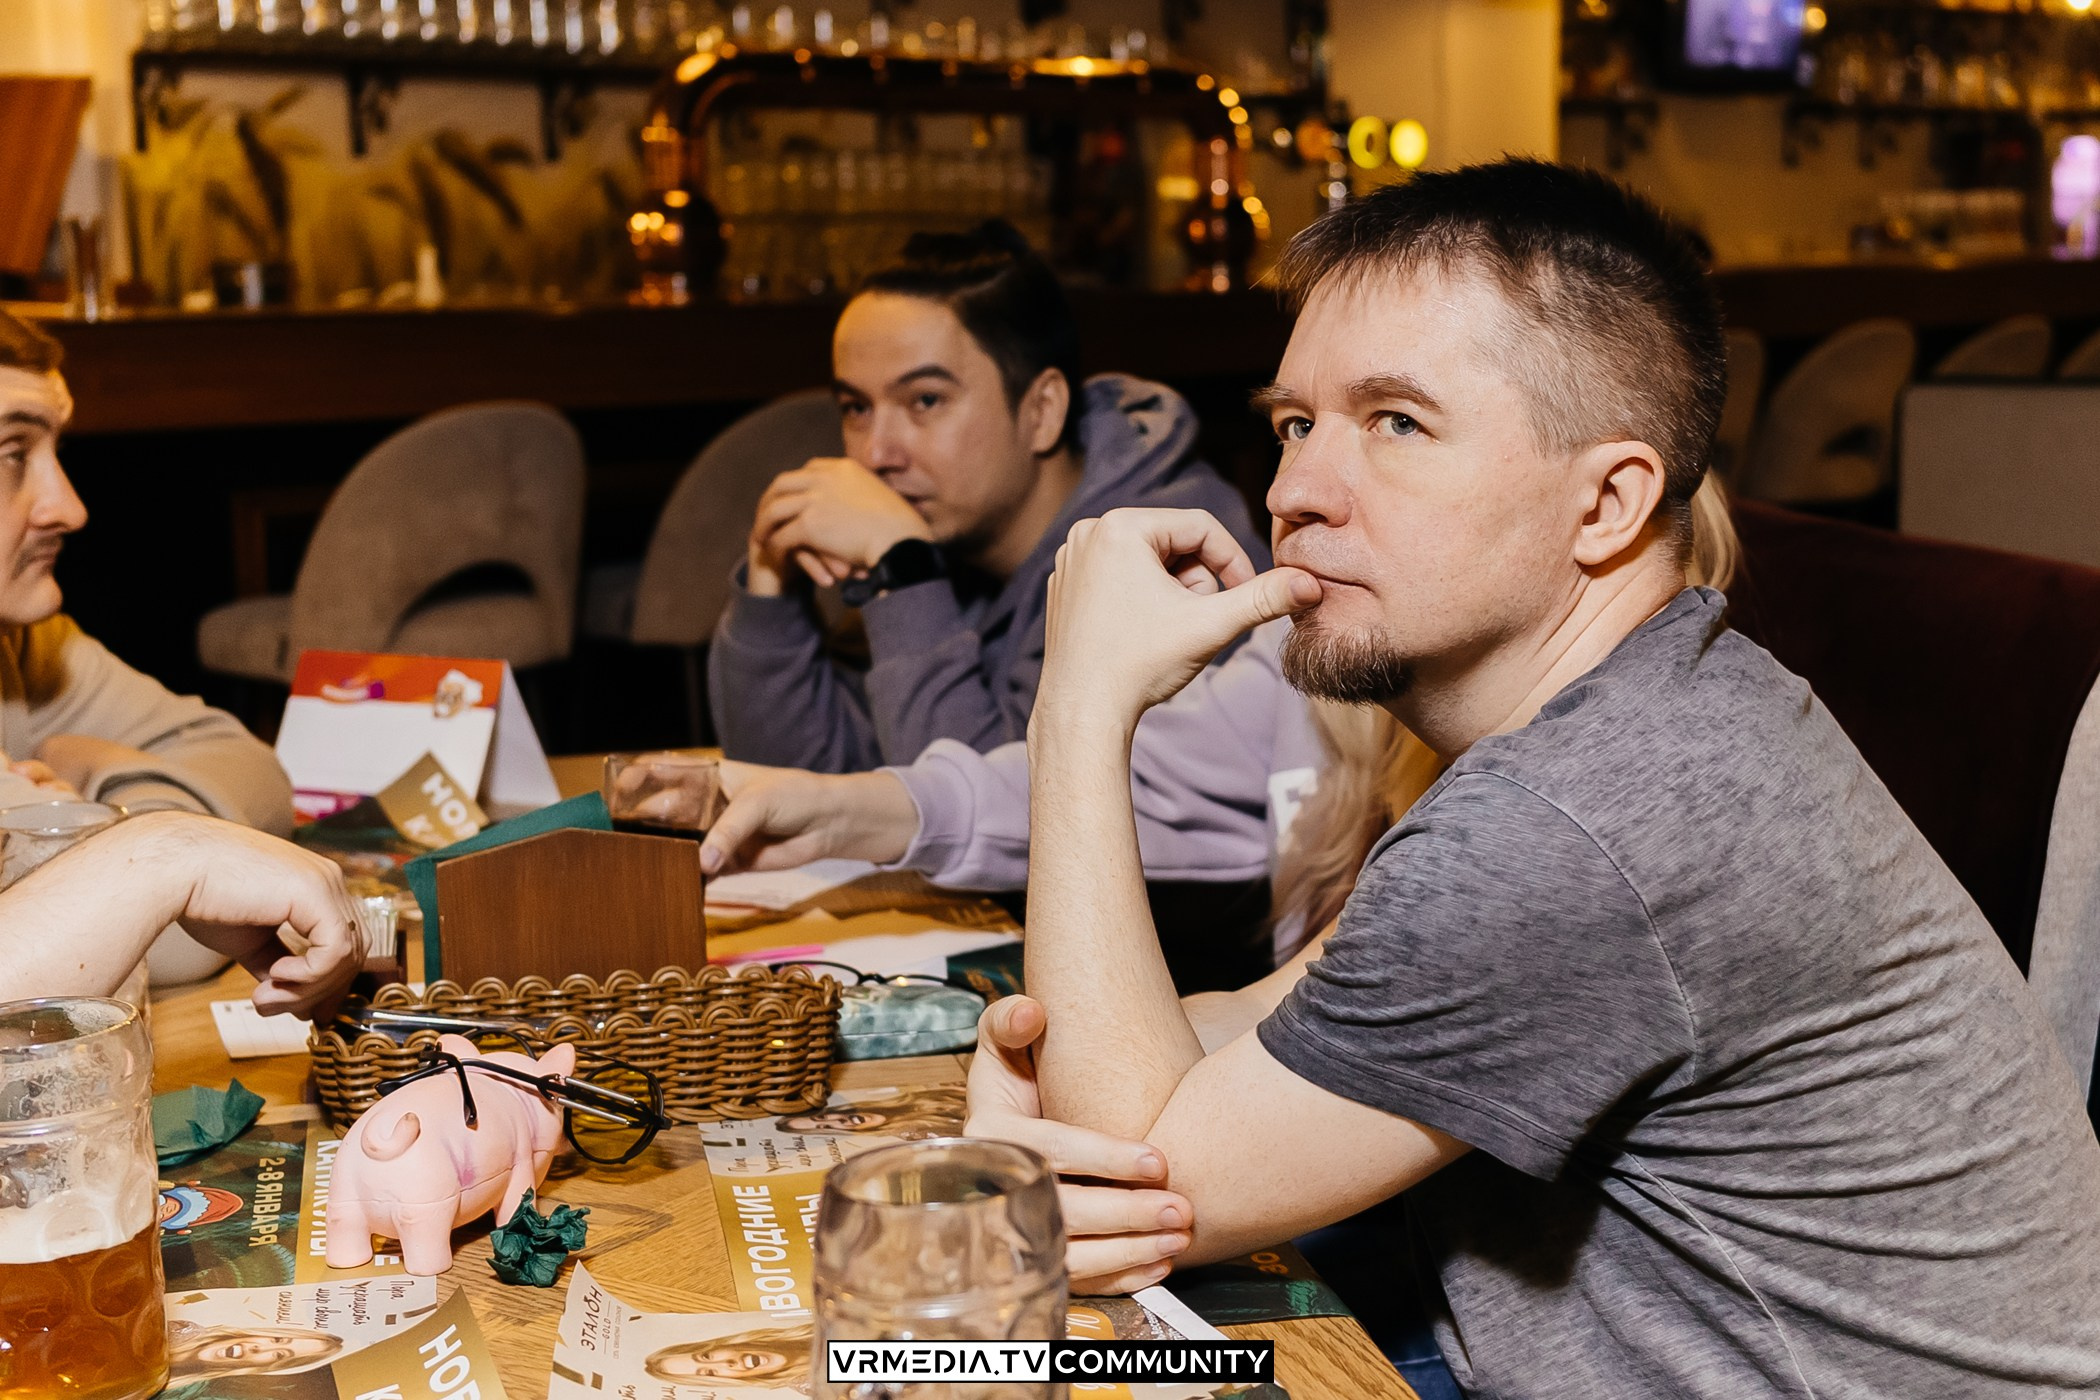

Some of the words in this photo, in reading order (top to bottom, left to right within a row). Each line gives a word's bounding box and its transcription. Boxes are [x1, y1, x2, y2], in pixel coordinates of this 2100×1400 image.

[257, 1156, 286, 1182] 2-8
[249, 1182, 284, 1247] ЯНВАРЯ
[732, 1185, 812, 1317] ВОГОДНИЕ
[301, 1288, 331, 1304] мир
[376, 1280, 415, 1300] Пора
[580, 1285, 603, 1351] ЭТАЛОН
[602, 1317, 611, 1340] GOLD
